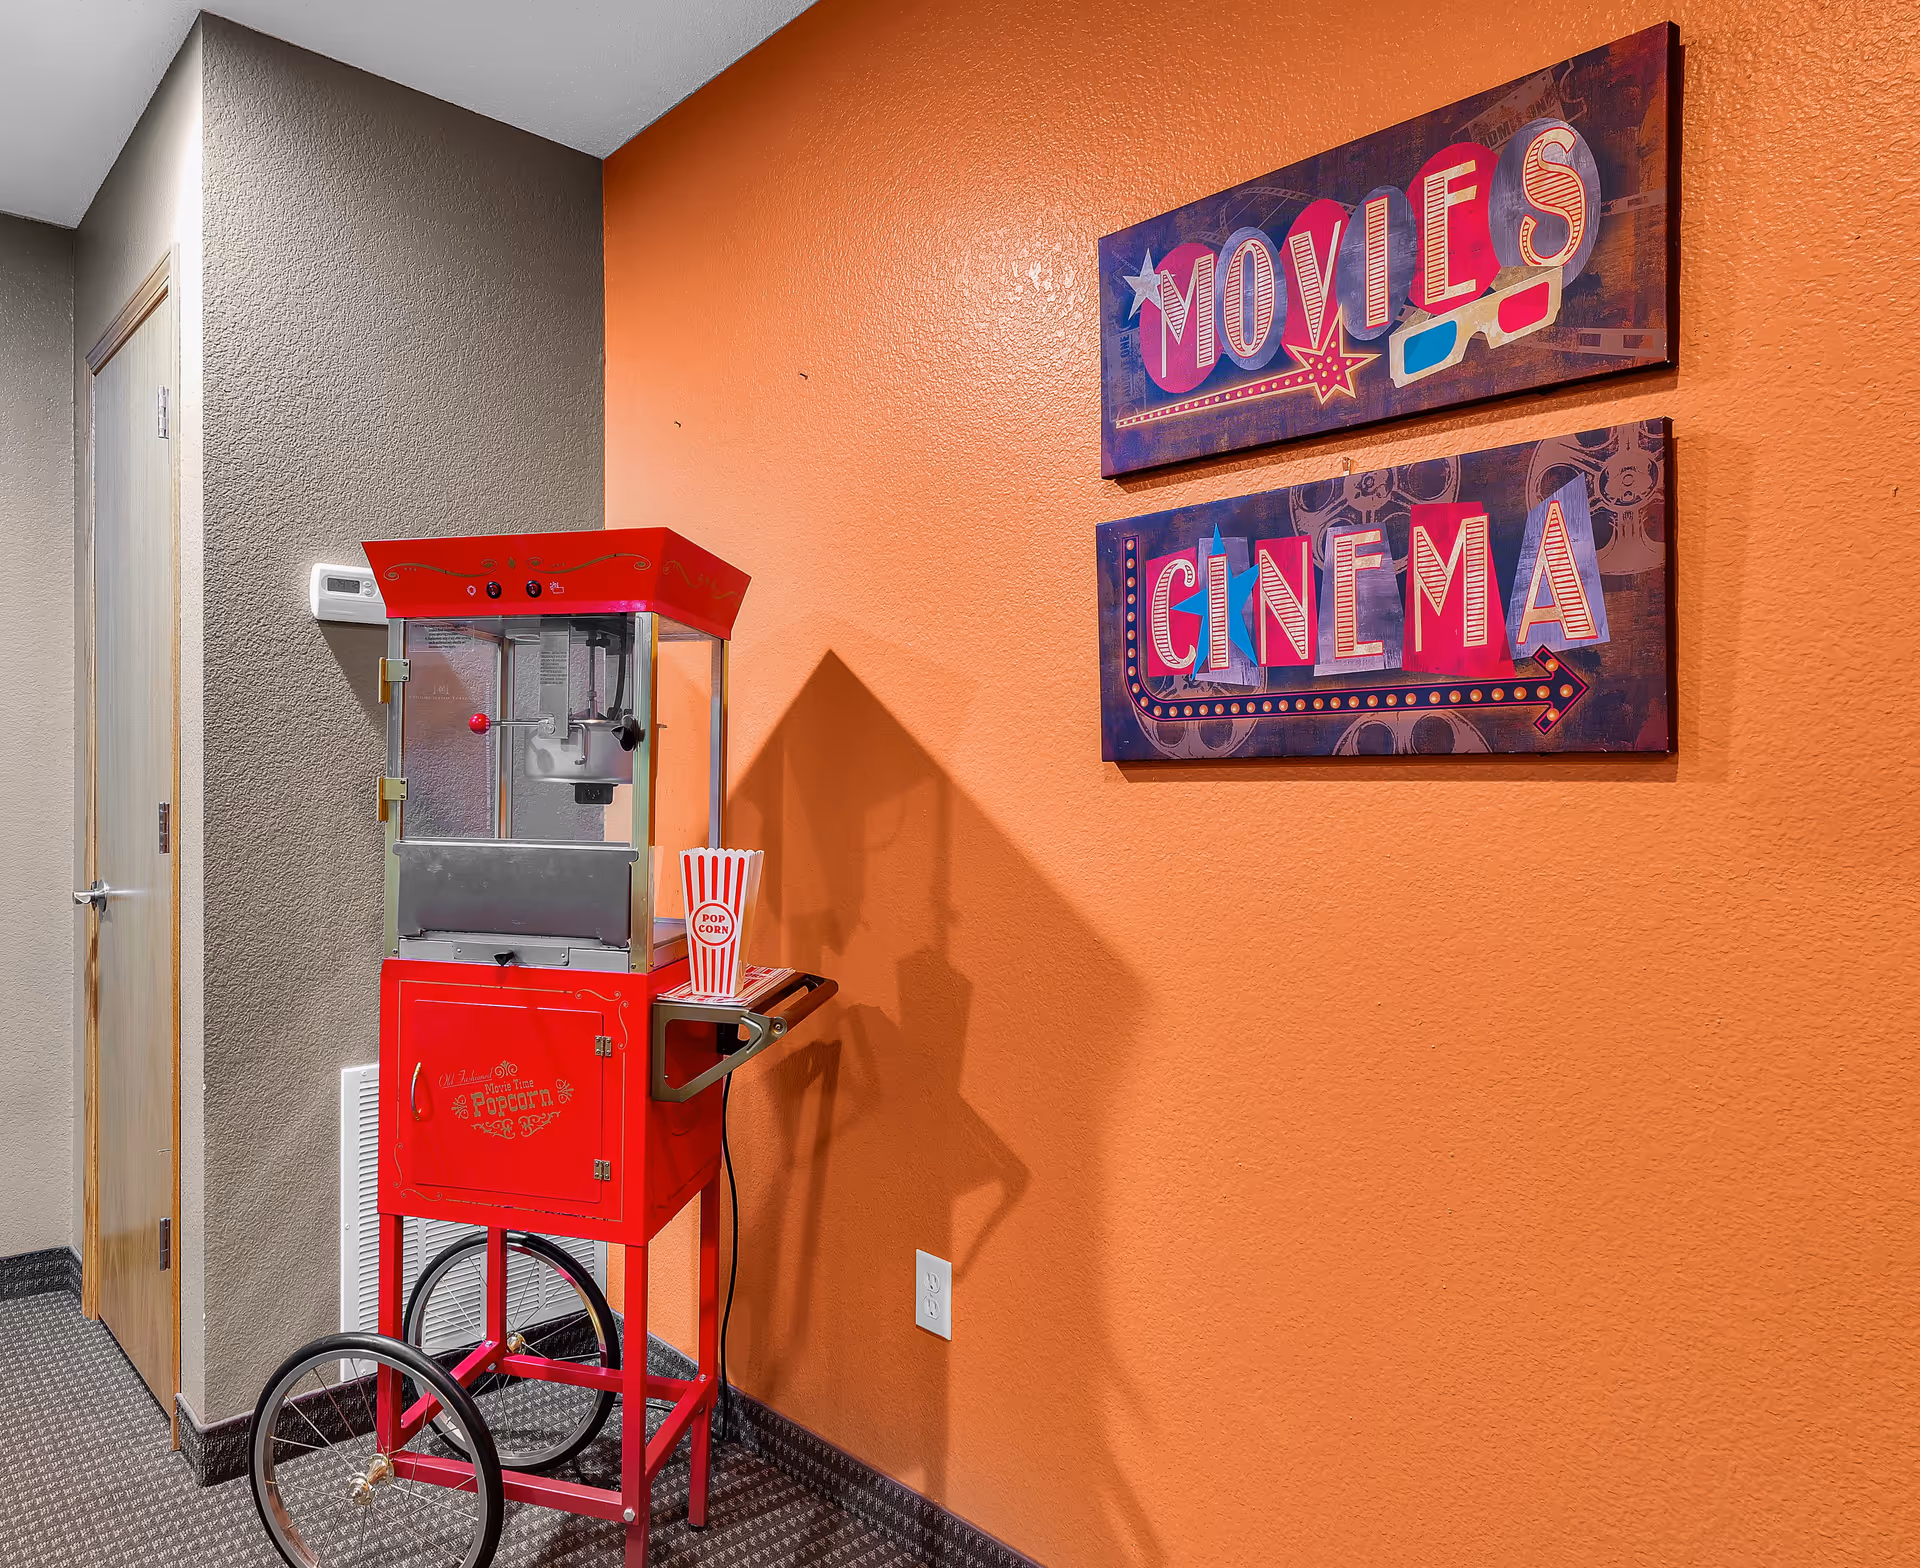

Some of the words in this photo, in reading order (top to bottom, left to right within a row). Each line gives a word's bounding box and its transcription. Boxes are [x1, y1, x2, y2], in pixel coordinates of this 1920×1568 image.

[1480, 115, 1521, 149] ADM
[1160, 126, 1587, 379] MOVIES
[1119, 333, 1130, 358] ONE
[1150, 500, 1598, 669] CINEMA
[698, 925, 728, 934] CORN
[702, 914, 725, 923] POP
[438, 1072, 455, 1088] Old
[458, 1067, 493, 1084] Fashioned
[484, 1083, 512, 1095] Movie
[513, 1079, 534, 1090] Time
[471, 1088, 554, 1117] Popcorn
